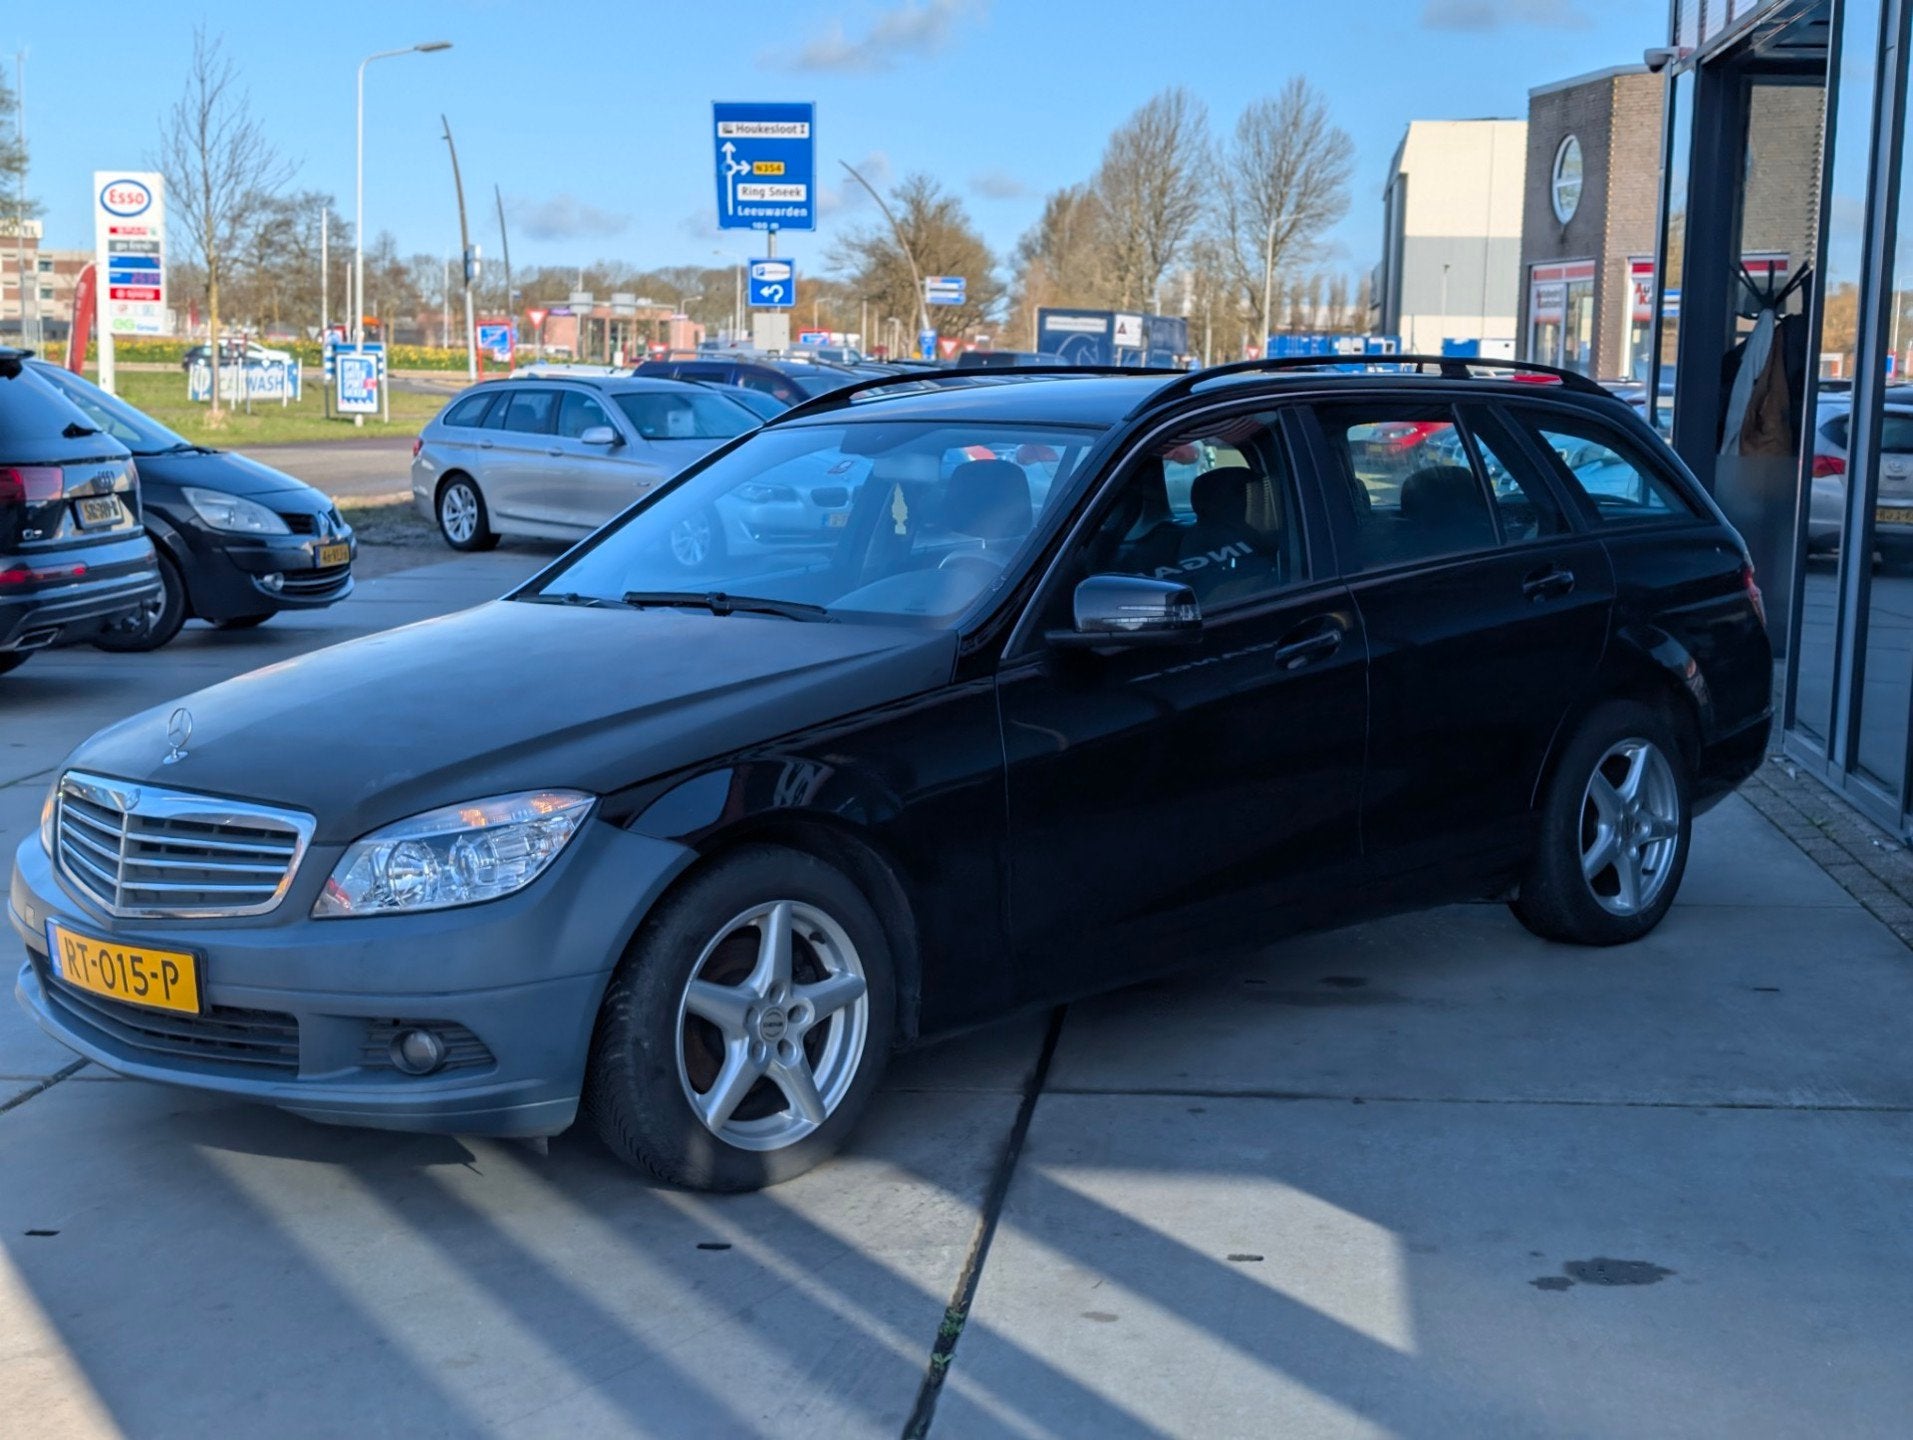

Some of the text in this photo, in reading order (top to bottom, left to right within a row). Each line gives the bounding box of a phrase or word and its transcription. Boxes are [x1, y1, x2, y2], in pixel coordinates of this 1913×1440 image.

[735, 124, 798, 134] Houkesloot
[109, 188, 145, 205] Esso
[741, 187, 802, 198] Ring Sneek
[737, 206, 808, 217] Leeuwarden
[247, 376, 284, 391] WASH
[64, 936, 179, 1001] RT-015-P
